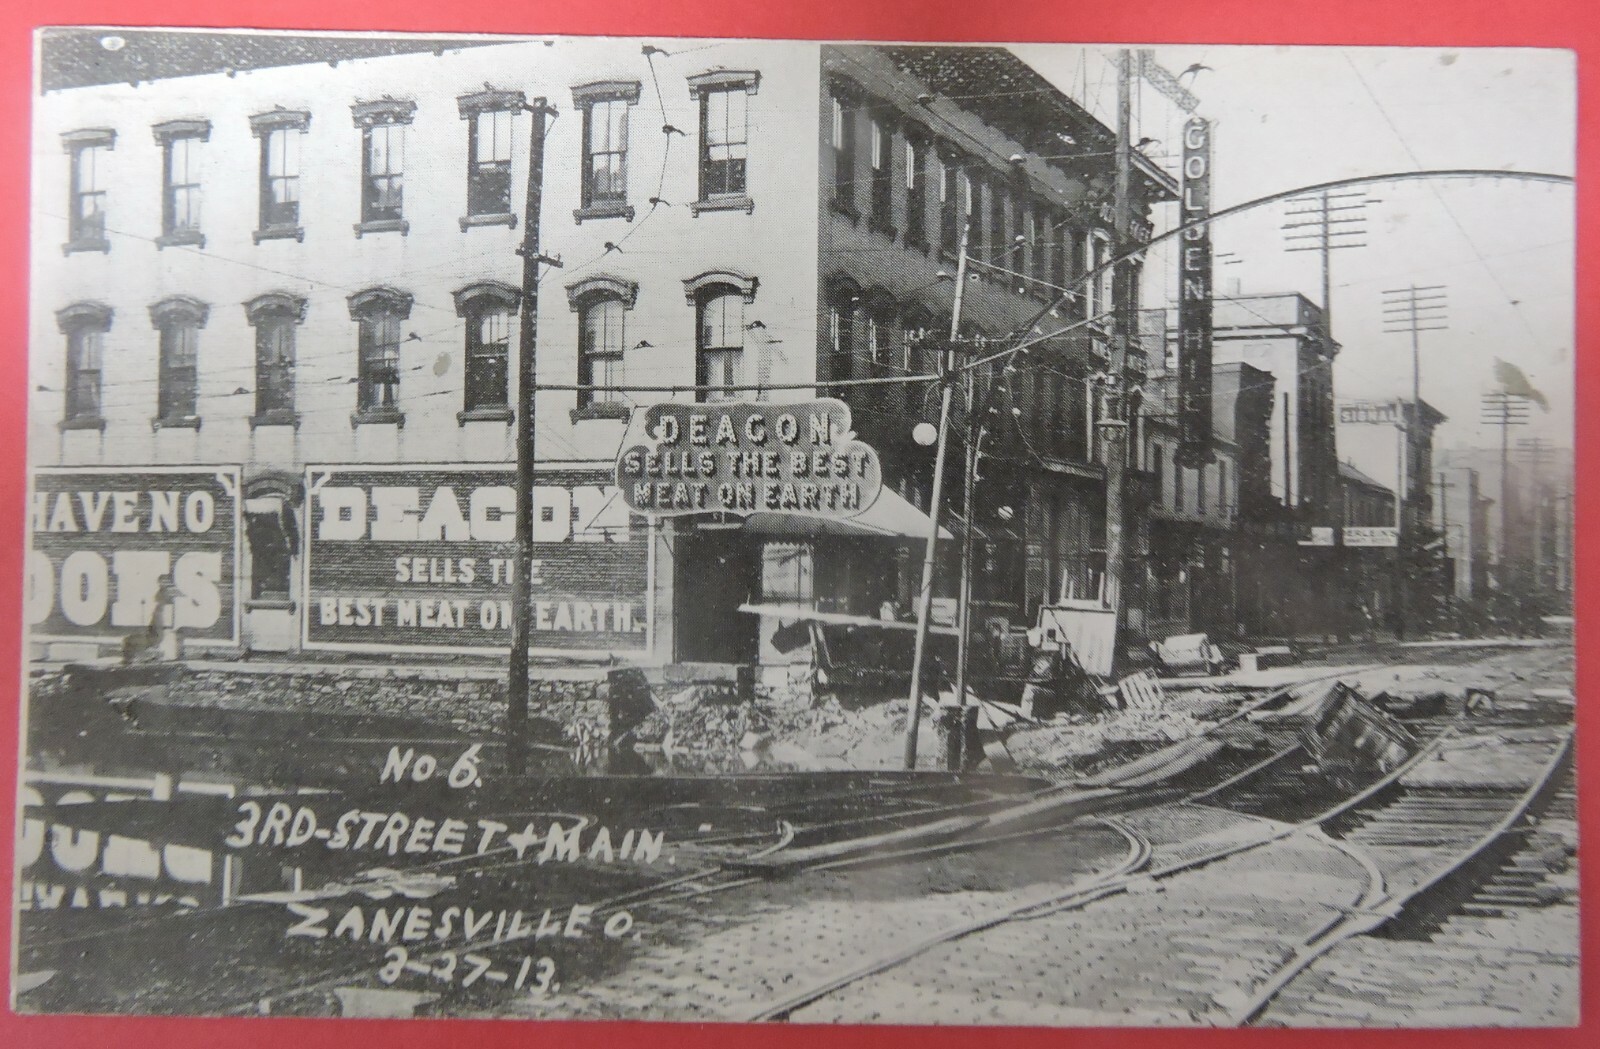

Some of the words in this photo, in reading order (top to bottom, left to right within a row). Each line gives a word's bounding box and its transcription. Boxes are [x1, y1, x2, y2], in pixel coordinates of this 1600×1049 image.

[1185, 125, 1206, 300] GOLDEN
[660, 413, 833, 447] DEACON
[624, 450, 717, 477] SELLS
[727, 450, 781, 477] THE
[790, 450, 870, 477] BEST
[31, 490, 140, 533] HAVE
[149, 490, 215, 533] NO
[319, 485, 631, 543] DEACON
[633, 481, 707, 508] MEAT
[717, 482, 754, 509] ON
[763, 482, 861, 510] EARTH
[395, 557, 477, 585] SELLS
[320, 598, 385, 627] BEST
[397, 599, 471, 629] MEAT
[227, 800, 507, 857] 3RD-STREET
[286, 903, 594, 944] ZANESVILLE
